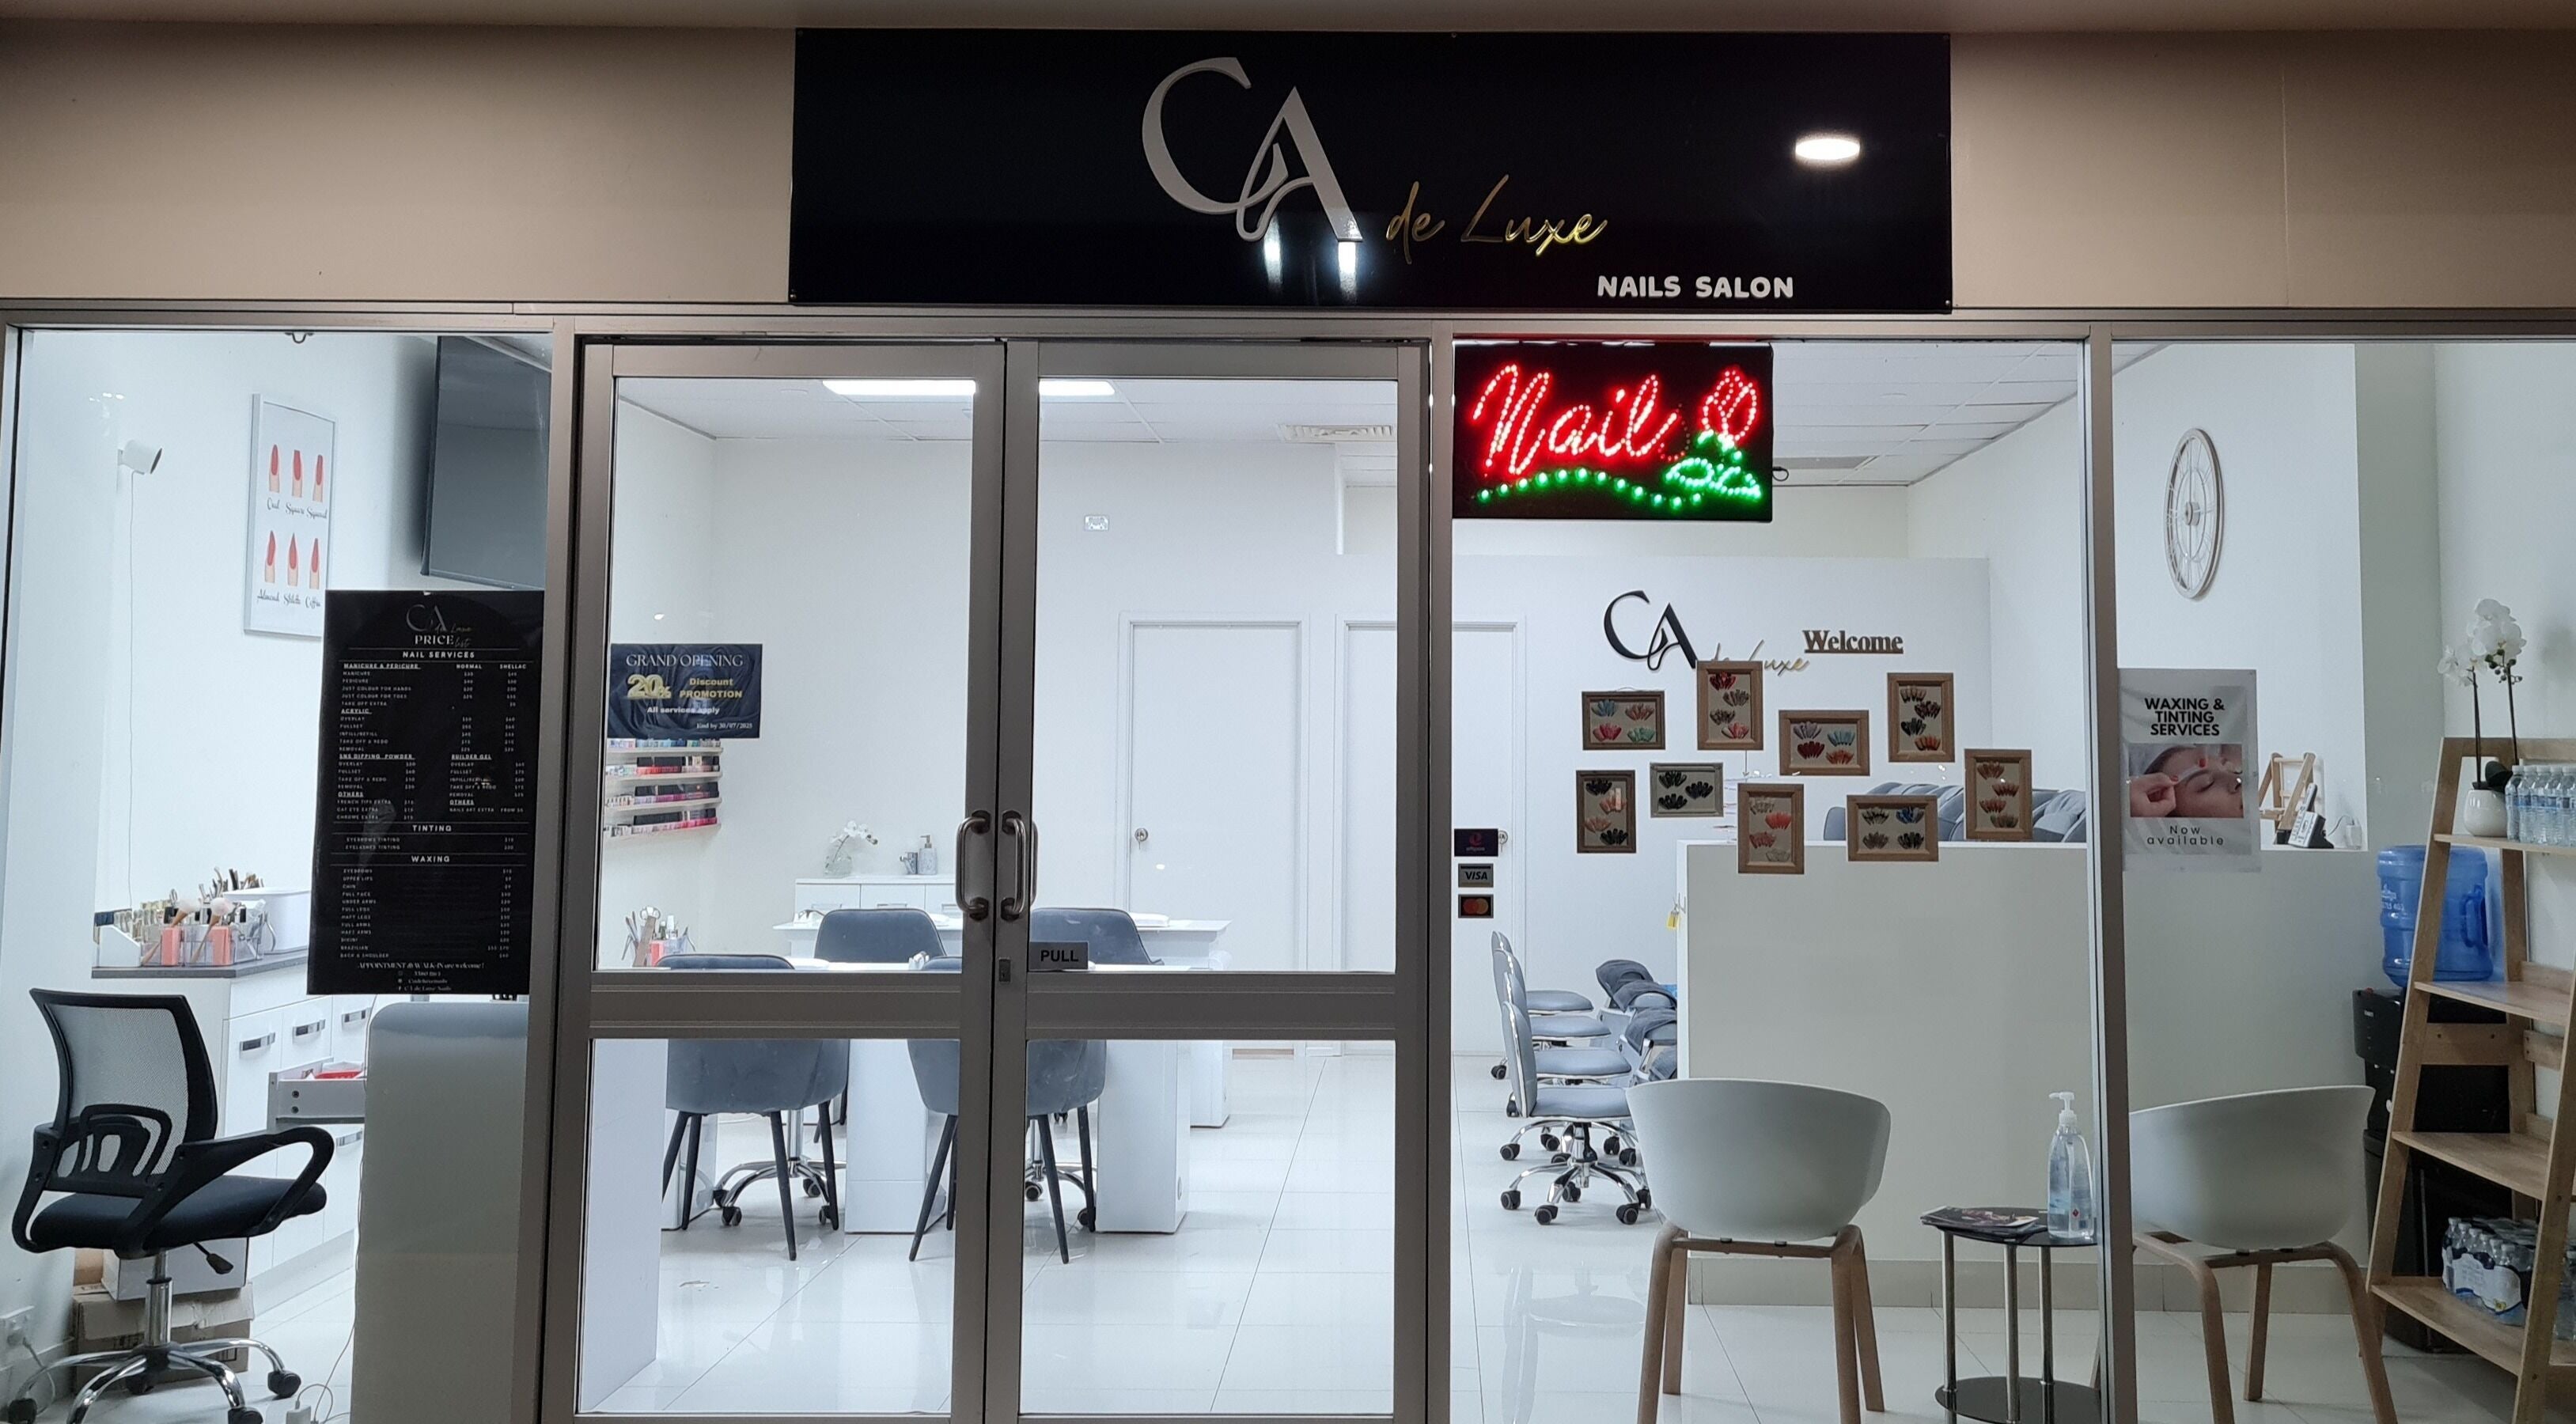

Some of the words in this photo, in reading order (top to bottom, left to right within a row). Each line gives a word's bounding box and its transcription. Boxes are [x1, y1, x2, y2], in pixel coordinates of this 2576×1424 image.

[1142, 56, 1362, 243] CA
[1385, 180, 1442, 265] de
[1459, 174, 1608, 258] Luxe
[1597, 275, 1681, 297] NAILS
[1695, 276, 1794, 298] SALON
[415, 634, 454, 645] PRICE
[1801, 629, 1904, 654] Welcome
[625, 653, 677, 668] GRAND
[680, 653, 744, 668] OPENING
[689, 677, 734, 687] Discount
[679, 690, 743, 699] PROMOTION
[2145, 698, 2209, 710] WAXING
[2212, 698, 2226, 710] &
[695, 706, 720, 715] apply
[2154, 710, 2215, 724] TINTING
[2150, 723, 2221, 737] SERVICES
[2169, 825, 2201, 835] Now
[2146, 835, 2224, 846] available
[1464, 871, 1488, 880] VISA
[1040, 949, 1079, 962] PULL
